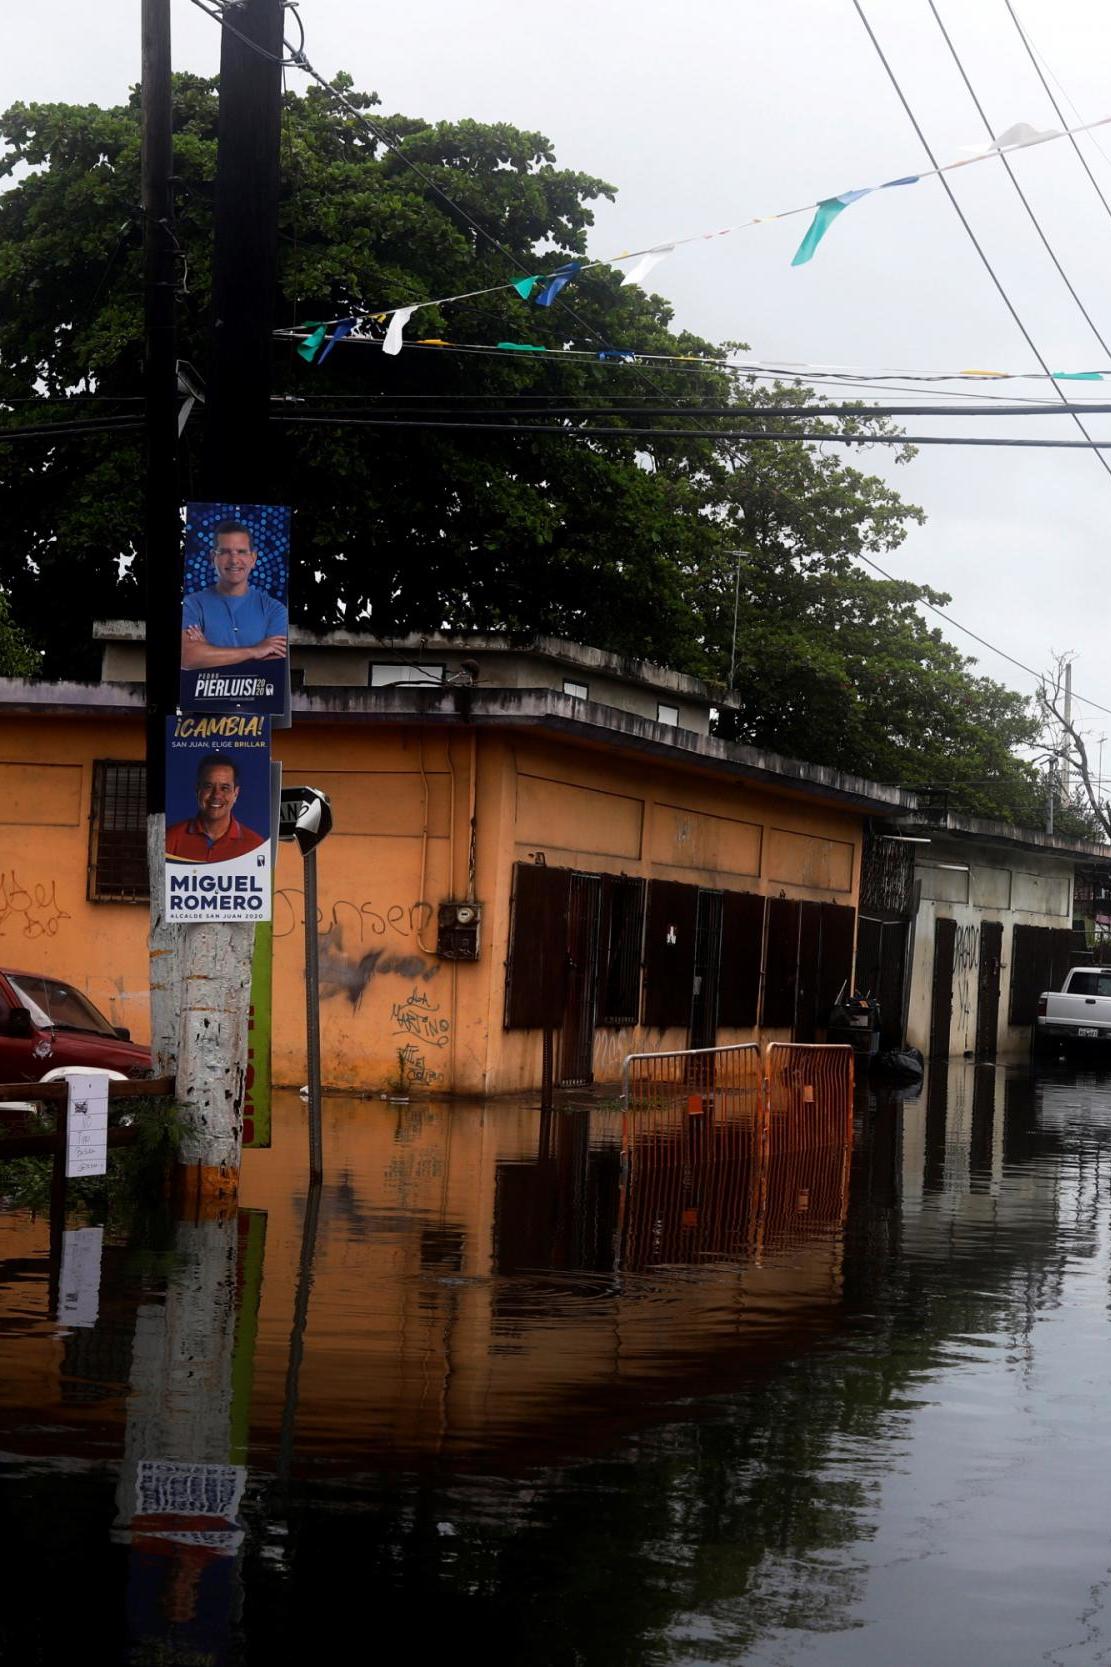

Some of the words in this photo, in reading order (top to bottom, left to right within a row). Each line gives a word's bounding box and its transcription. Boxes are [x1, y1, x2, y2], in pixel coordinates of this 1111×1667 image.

[195, 679, 257, 697] PIERLUISI
[174, 716, 265, 738] ¡CAMBIA!
[171, 876, 263, 892] MIGUEL
[170, 896, 263, 910] ROMERO
